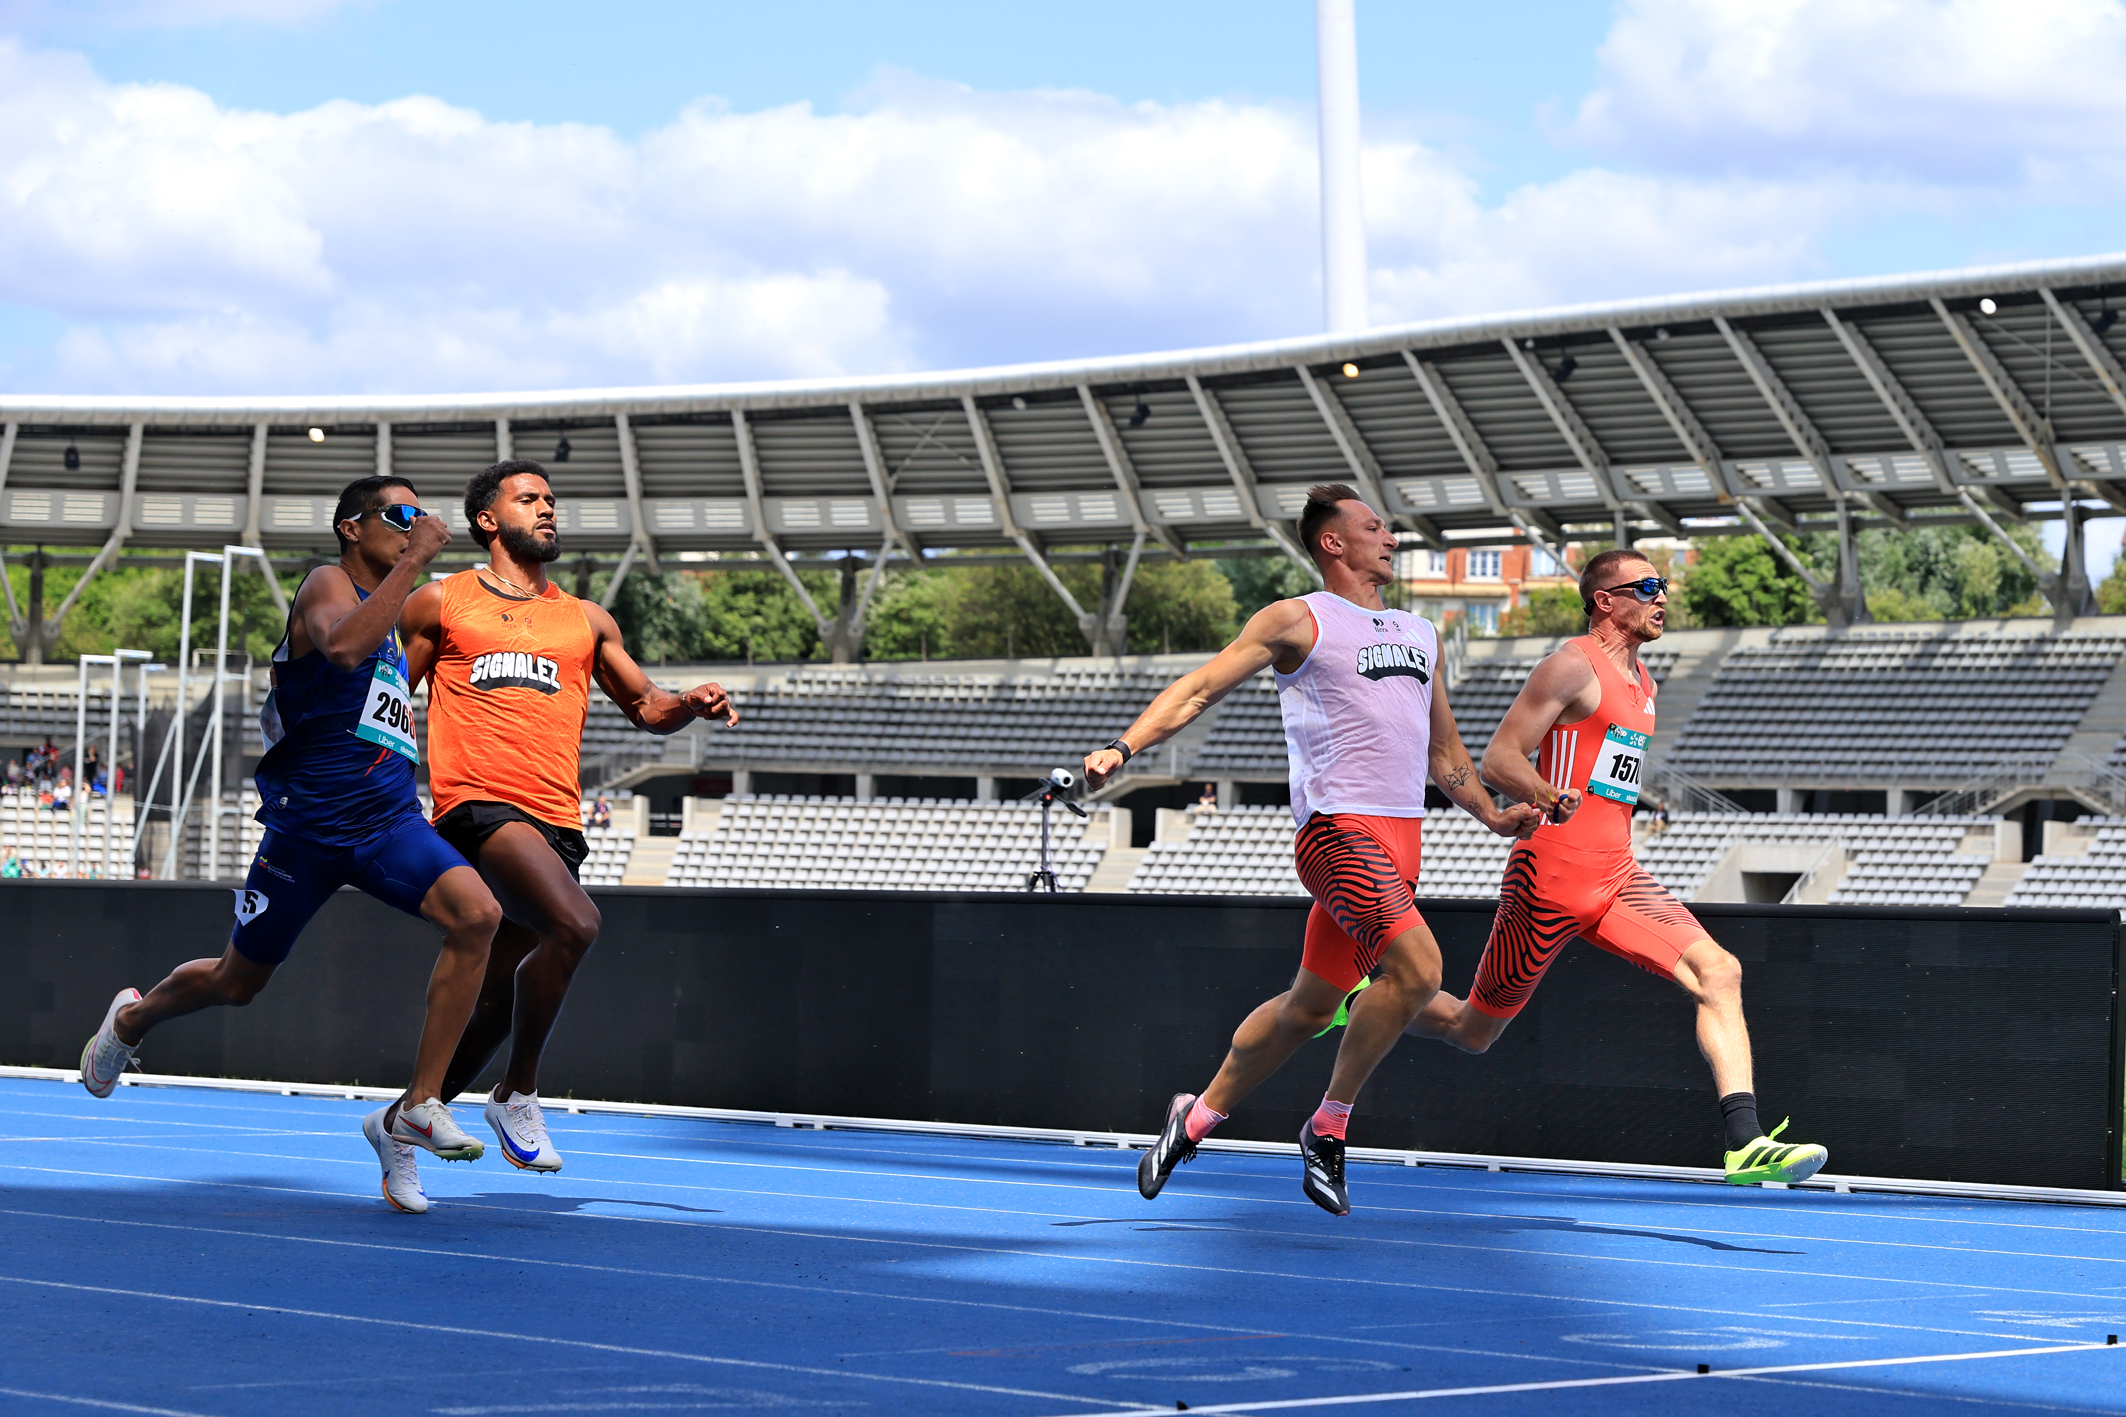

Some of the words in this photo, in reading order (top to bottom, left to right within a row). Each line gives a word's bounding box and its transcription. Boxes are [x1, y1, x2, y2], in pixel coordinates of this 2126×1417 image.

[468, 651, 562, 694] SIGNALEZ
[1357, 643, 1430, 684] SIGNALEZ
[242, 890, 259, 914] 5
